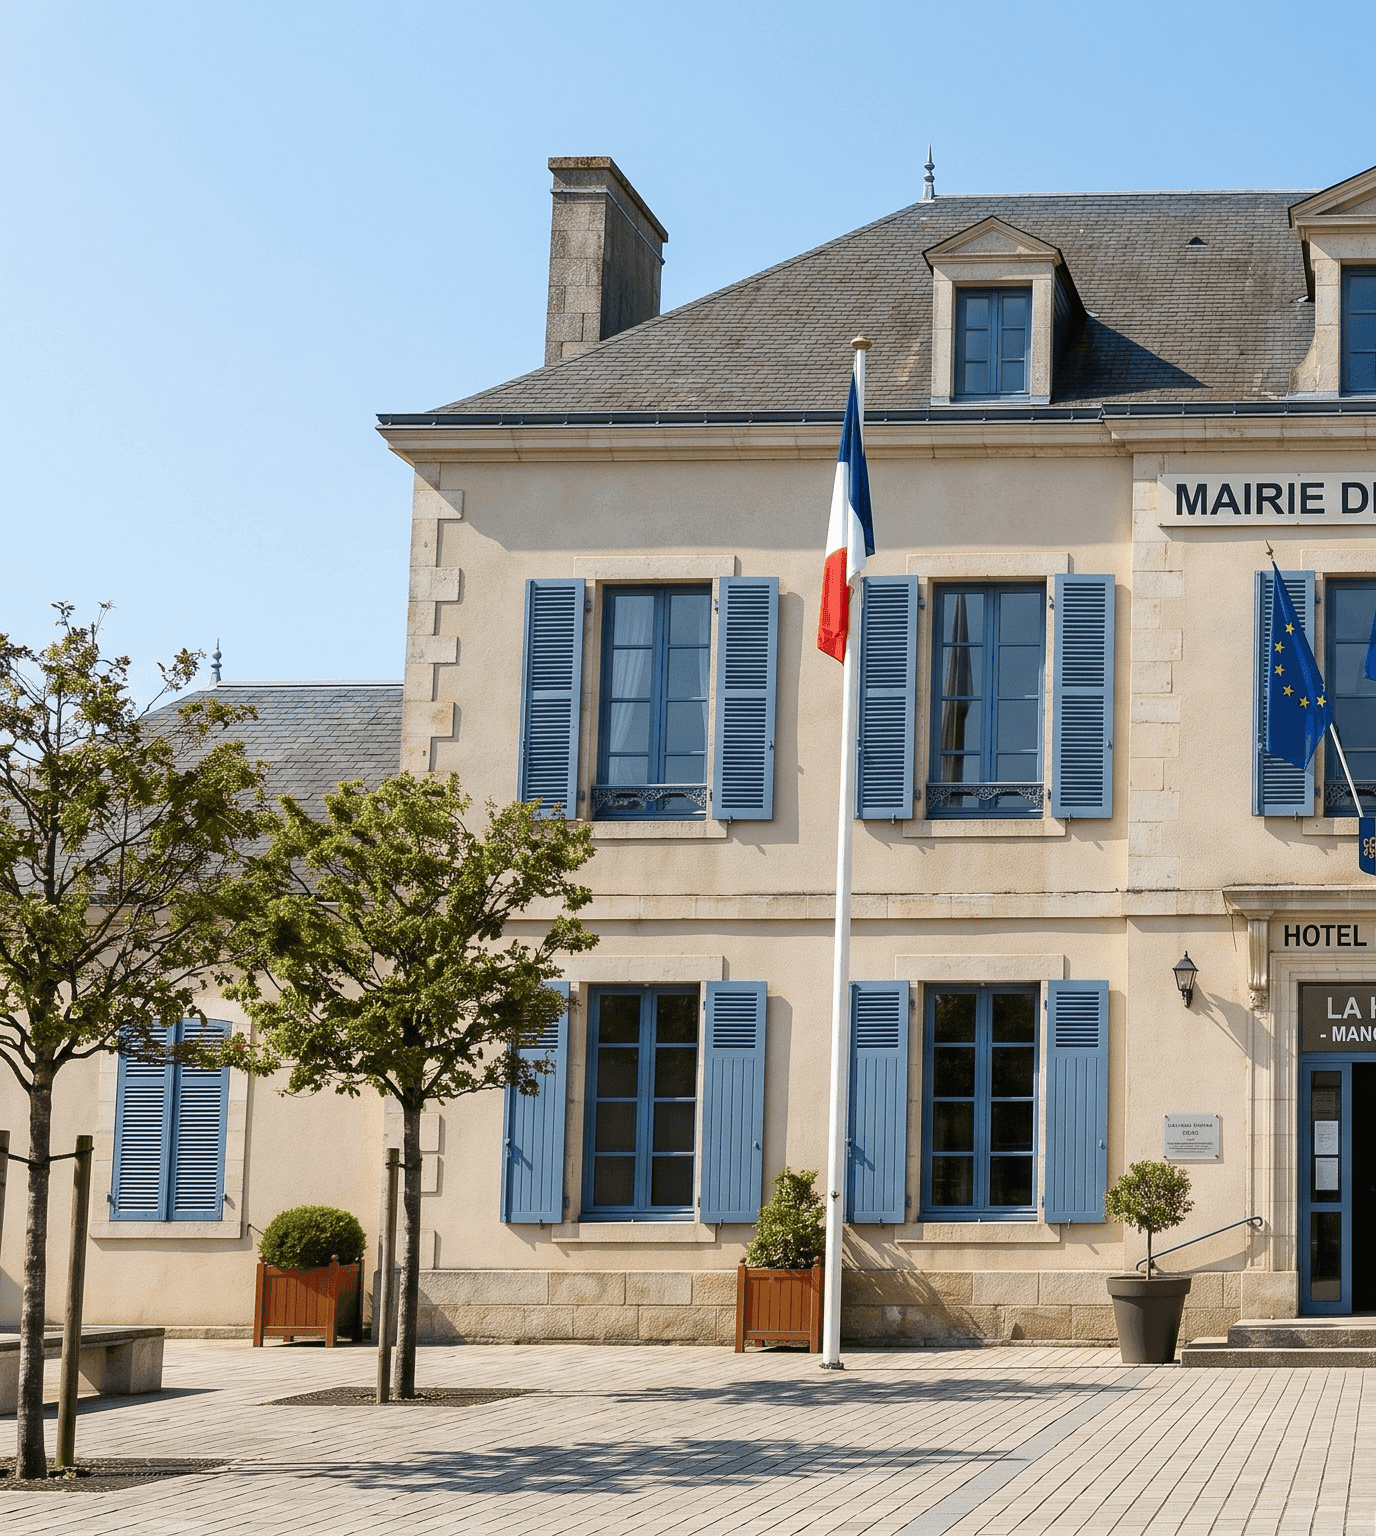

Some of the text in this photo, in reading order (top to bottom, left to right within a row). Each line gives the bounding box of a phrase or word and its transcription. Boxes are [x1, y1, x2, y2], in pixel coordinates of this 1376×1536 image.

[1176, 482, 1326, 516] MAIRIE
[1284, 924, 1368, 947] HOTEL
[1327, 996, 1362, 1020] LA
